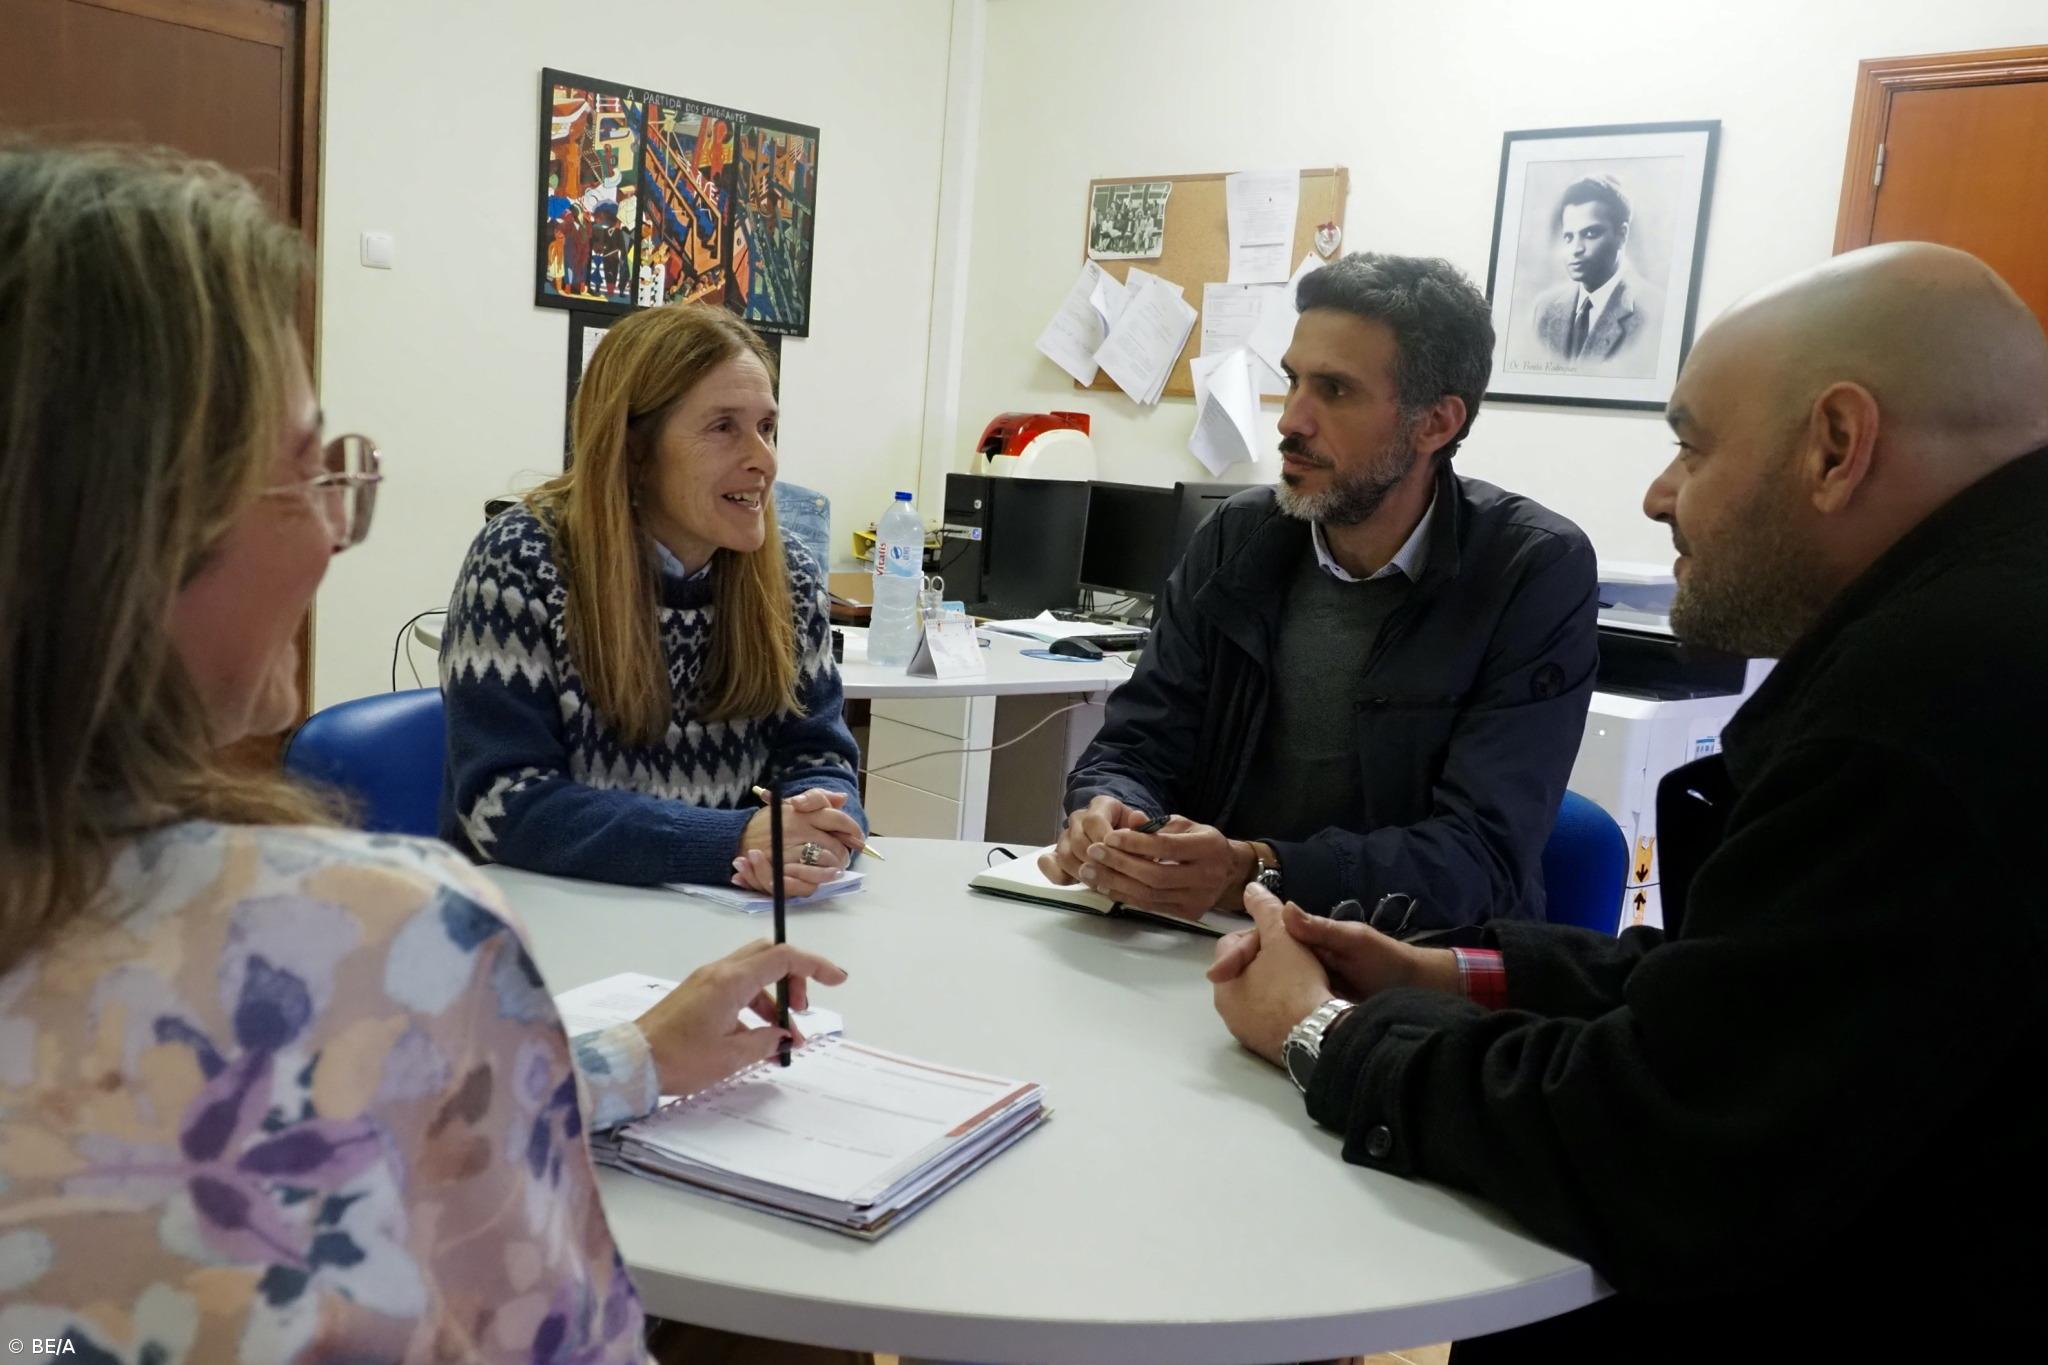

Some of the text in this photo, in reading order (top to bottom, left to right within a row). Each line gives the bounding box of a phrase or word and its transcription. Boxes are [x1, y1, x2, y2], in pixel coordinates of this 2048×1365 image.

[627, 88, 748, 123] A PARTIDA DOS EMIGRANTES
[876, 542, 888, 577] Vitalis
